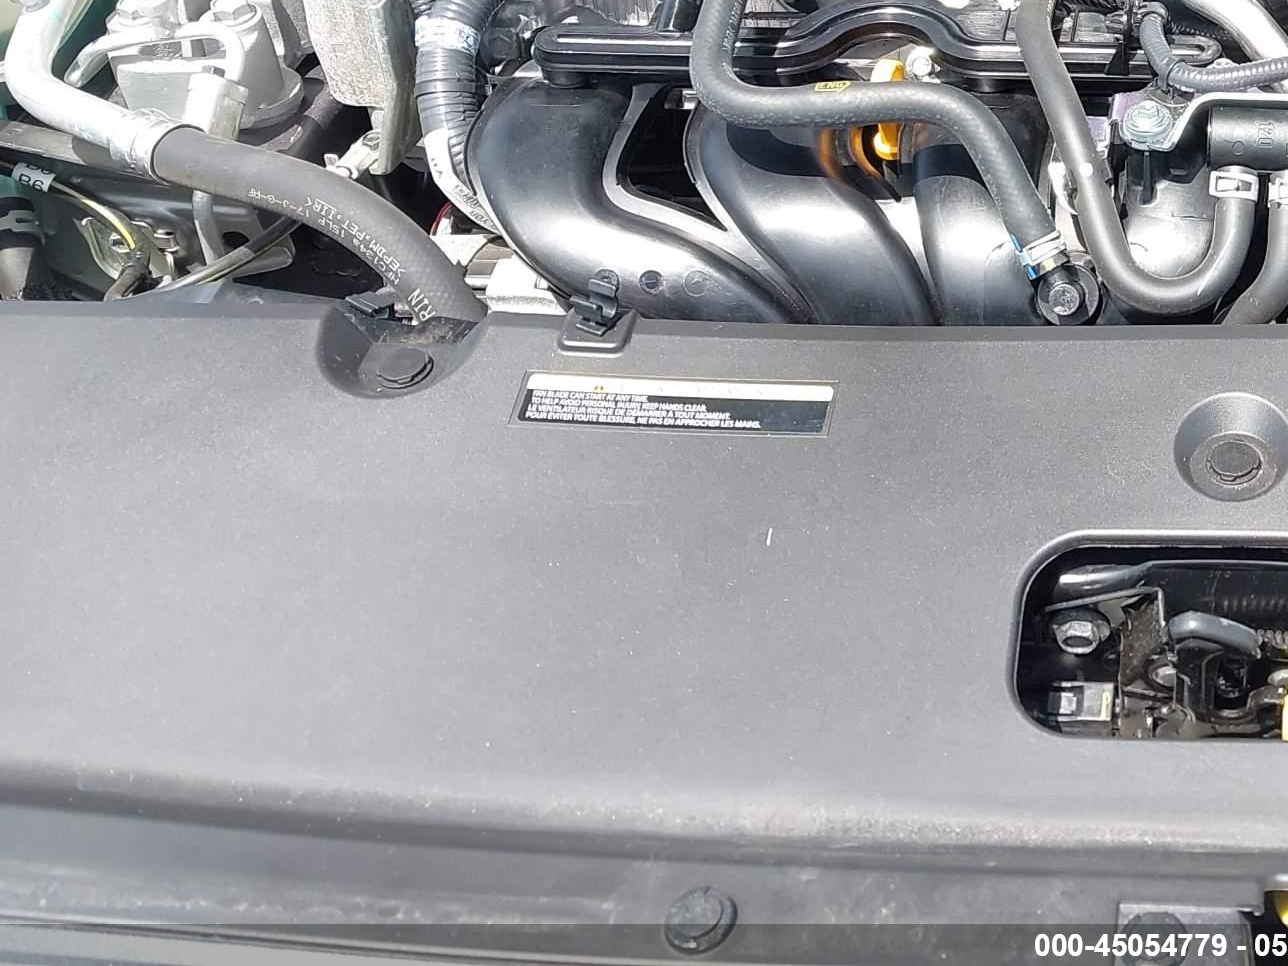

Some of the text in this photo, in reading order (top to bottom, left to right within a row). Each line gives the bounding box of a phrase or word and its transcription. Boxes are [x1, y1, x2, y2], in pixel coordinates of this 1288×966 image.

[547, 390, 569, 398] BLADE
[585, 392, 606, 400] START
[537, 404, 587, 413] VENTILATEUR
[587, 407, 614, 415] RISQUE
[673, 410, 694, 418] TOUT
[559, 398, 582, 406] AVOID
[582, 400, 615, 408] PERSONAL
[641, 402, 659, 410] KEEP
[659, 403, 684, 411] HANDS
[525, 411, 547, 419] POUR
[573, 414, 597, 422] TOUTE
[674, 418, 720, 427] APPROCHER
